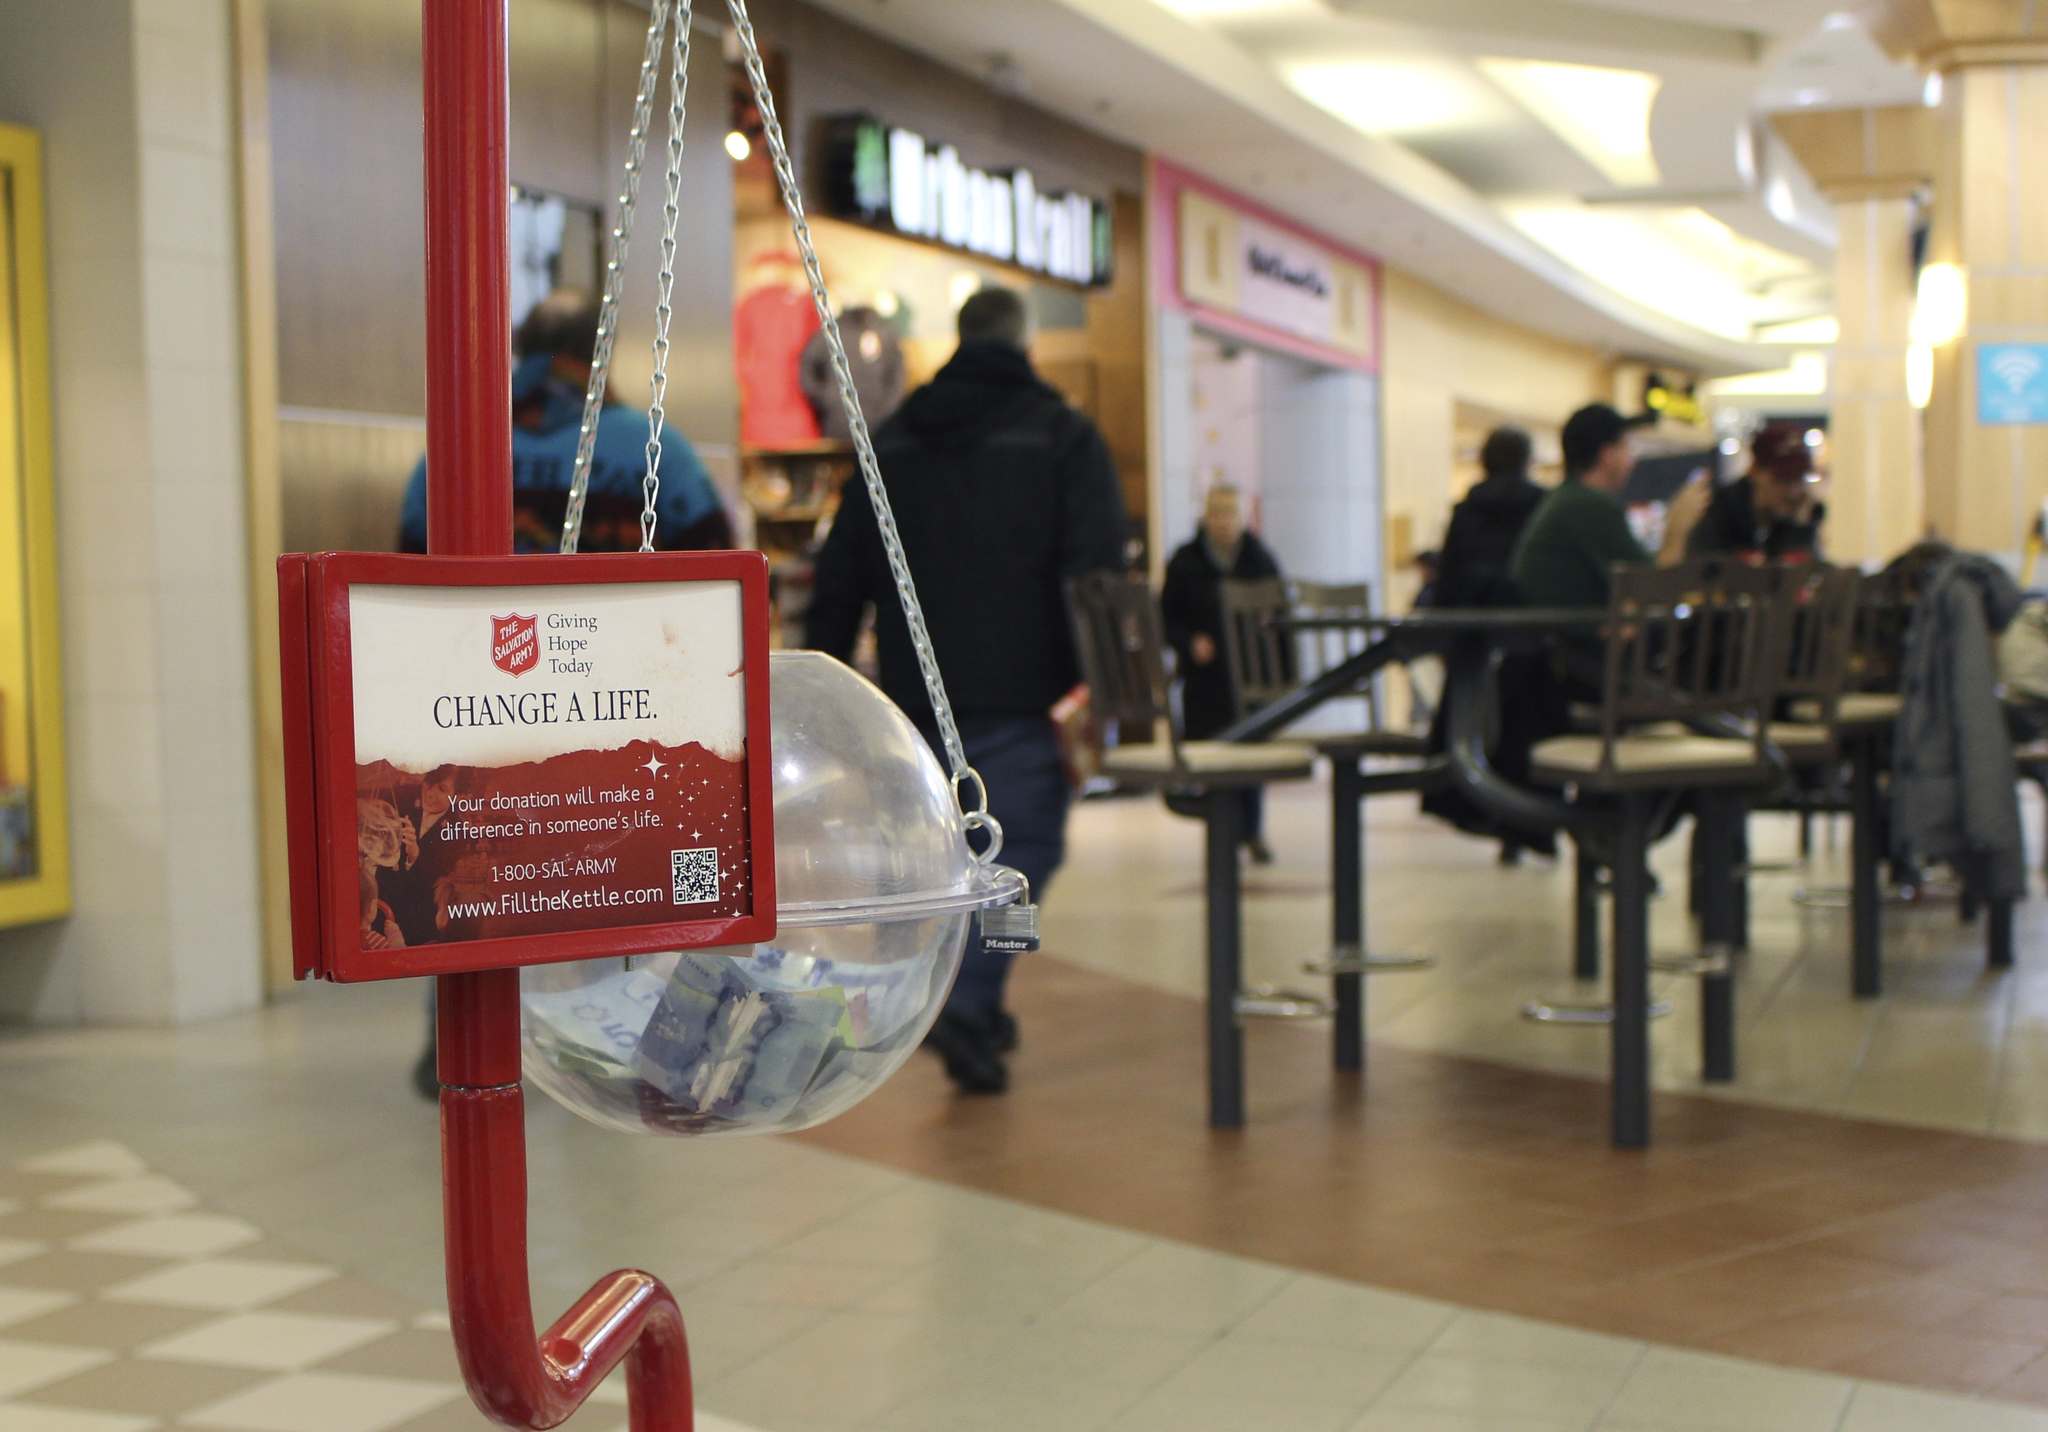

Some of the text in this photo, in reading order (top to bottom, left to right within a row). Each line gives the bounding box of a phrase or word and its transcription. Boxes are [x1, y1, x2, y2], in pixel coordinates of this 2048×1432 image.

[500, 620, 519, 641] THE
[547, 613, 599, 633] Giving
[494, 624, 535, 661] SALVATION
[509, 642, 535, 669] ARMY
[548, 635, 588, 656] Hope
[548, 658, 594, 678] Today
[433, 689, 658, 729] CHANGE A LIFE.
[447, 784, 655, 813] Your donation will make a
[440, 821, 524, 842] difference
[528, 819, 542, 836] in
[634, 809, 664, 829] life.
[491, 857, 618, 883] 1-800-SAL-ARMY
[447, 885, 664, 920] www.FilltheKettle.com
[985, 939, 1029, 950] Master
